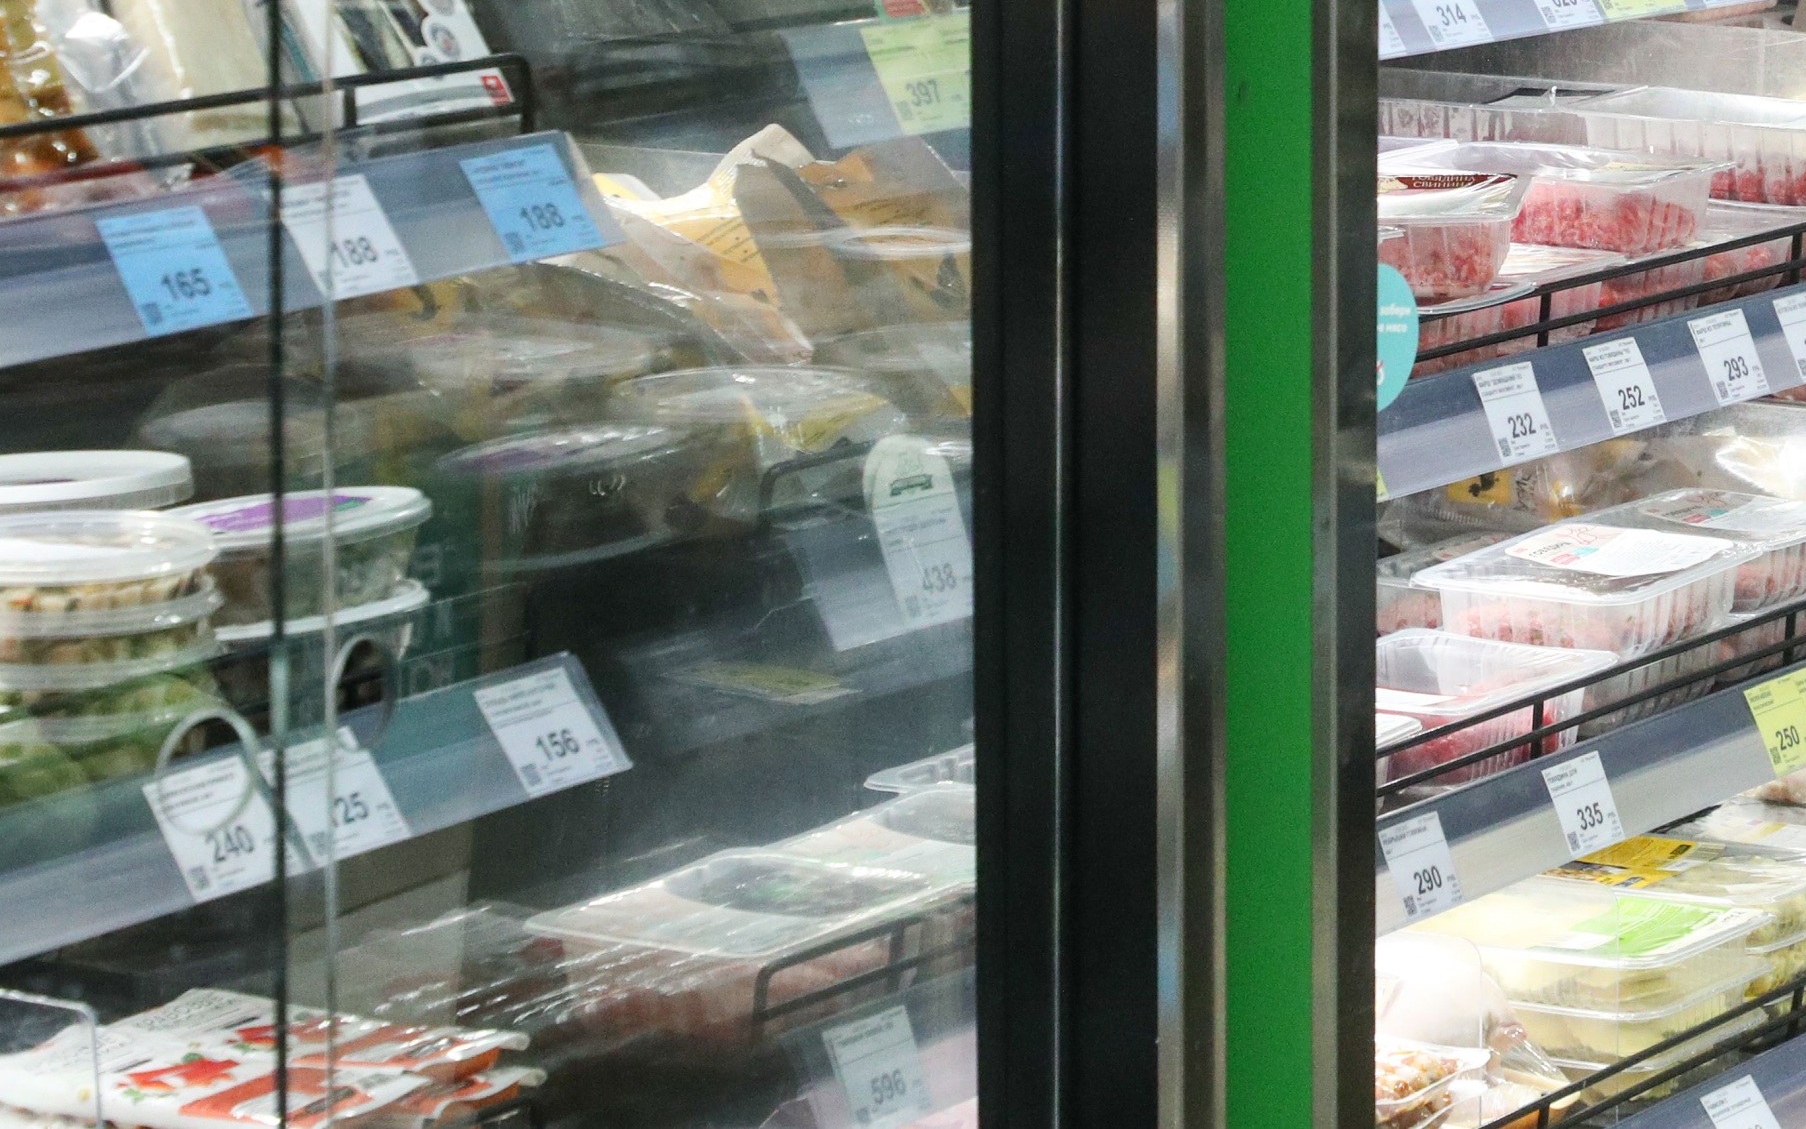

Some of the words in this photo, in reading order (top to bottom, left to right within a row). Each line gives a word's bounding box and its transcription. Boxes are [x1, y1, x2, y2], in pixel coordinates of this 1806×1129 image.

[1436, 2, 1467, 28] 314
[905, 78, 941, 108] 397
[519, 203, 567, 232] 188
[330, 236, 380, 269] 188
[160, 268, 211, 300] 165
[1723, 355, 1750, 382] 293
[1617, 385, 1646, 411] 252
[1507, 412, 1537, 440] 232
[535, 727, 581, 763] 156
[1775, 724, 1801, 751] 250
[1576, 801, 1604, 831] 335
[204, 824, 256, 864] 240
[1413, 864, 1443, 896] 290
